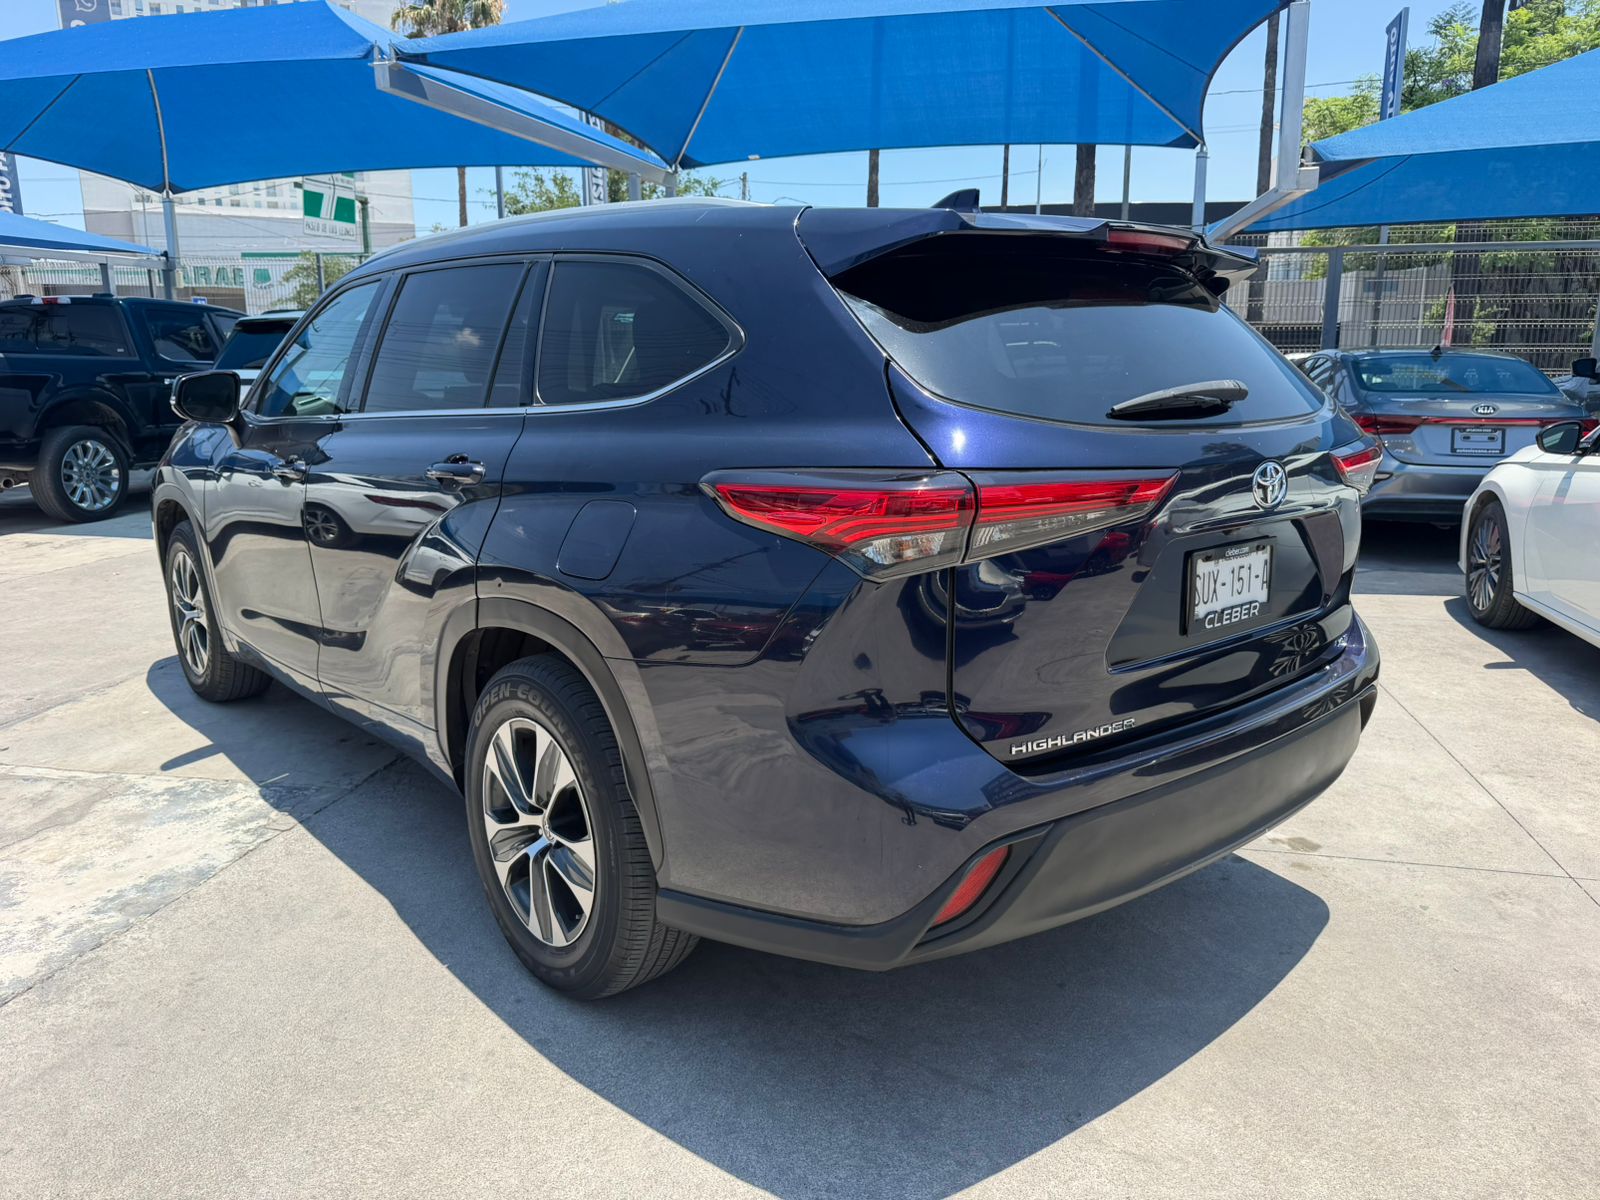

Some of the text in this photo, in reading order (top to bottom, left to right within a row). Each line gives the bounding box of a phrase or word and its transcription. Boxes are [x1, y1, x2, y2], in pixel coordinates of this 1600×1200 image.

[1477, 406, 1494, 414] KIA
[1195, 559, 1269, 607] SUX-151-A
[1205, 602, 1260, 629] CLEBER
[474, 682, 598, 796] OPEN COUNTRY
[1011, 718, 1136, 755] HIGHLANDER
